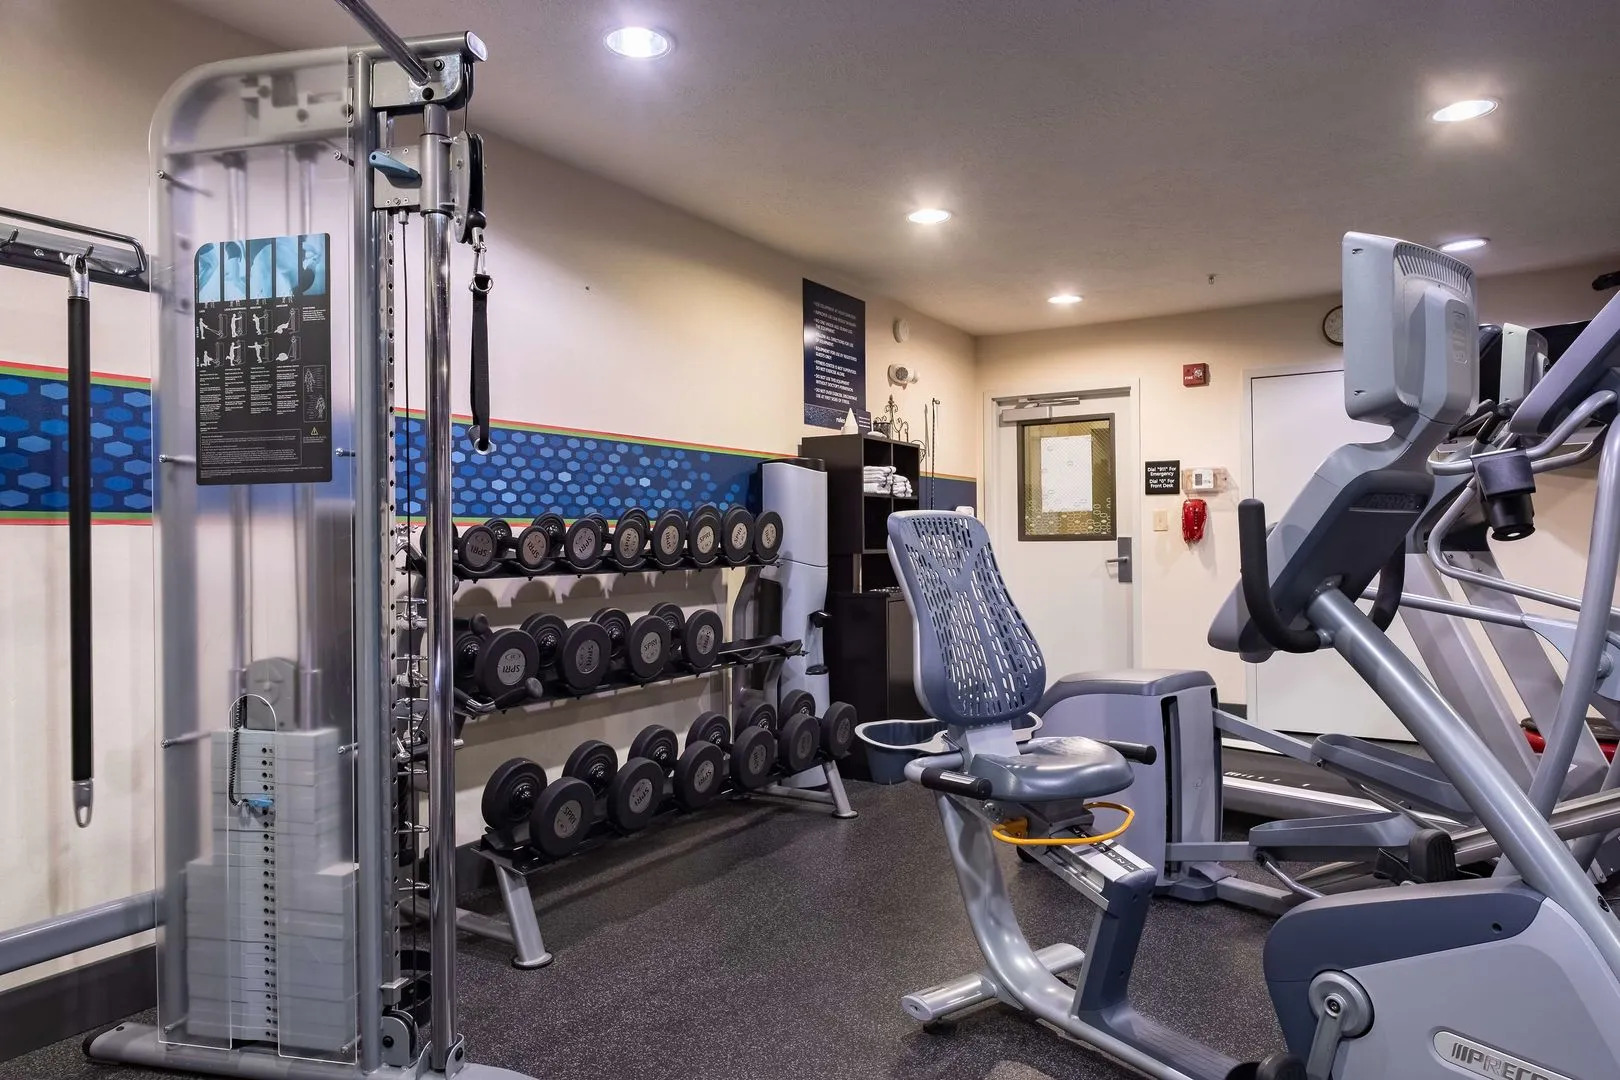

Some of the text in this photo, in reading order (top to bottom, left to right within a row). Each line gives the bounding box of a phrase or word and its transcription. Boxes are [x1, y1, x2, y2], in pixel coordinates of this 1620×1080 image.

[579, 536, 593, 553] SPRI
[623, 533, 631, 552] SPRI
[699, 531, 711, 542] SPRI
[470, 544, 487, 557] SPRI
[527, 540, 540, 559] SPRI
[643, 638, 658, 651] SPRI
[502, 664, 520, 673] SPRI
[634, 788, 650, 806] SPRI
[563, 807, 577, 824] SPRI
